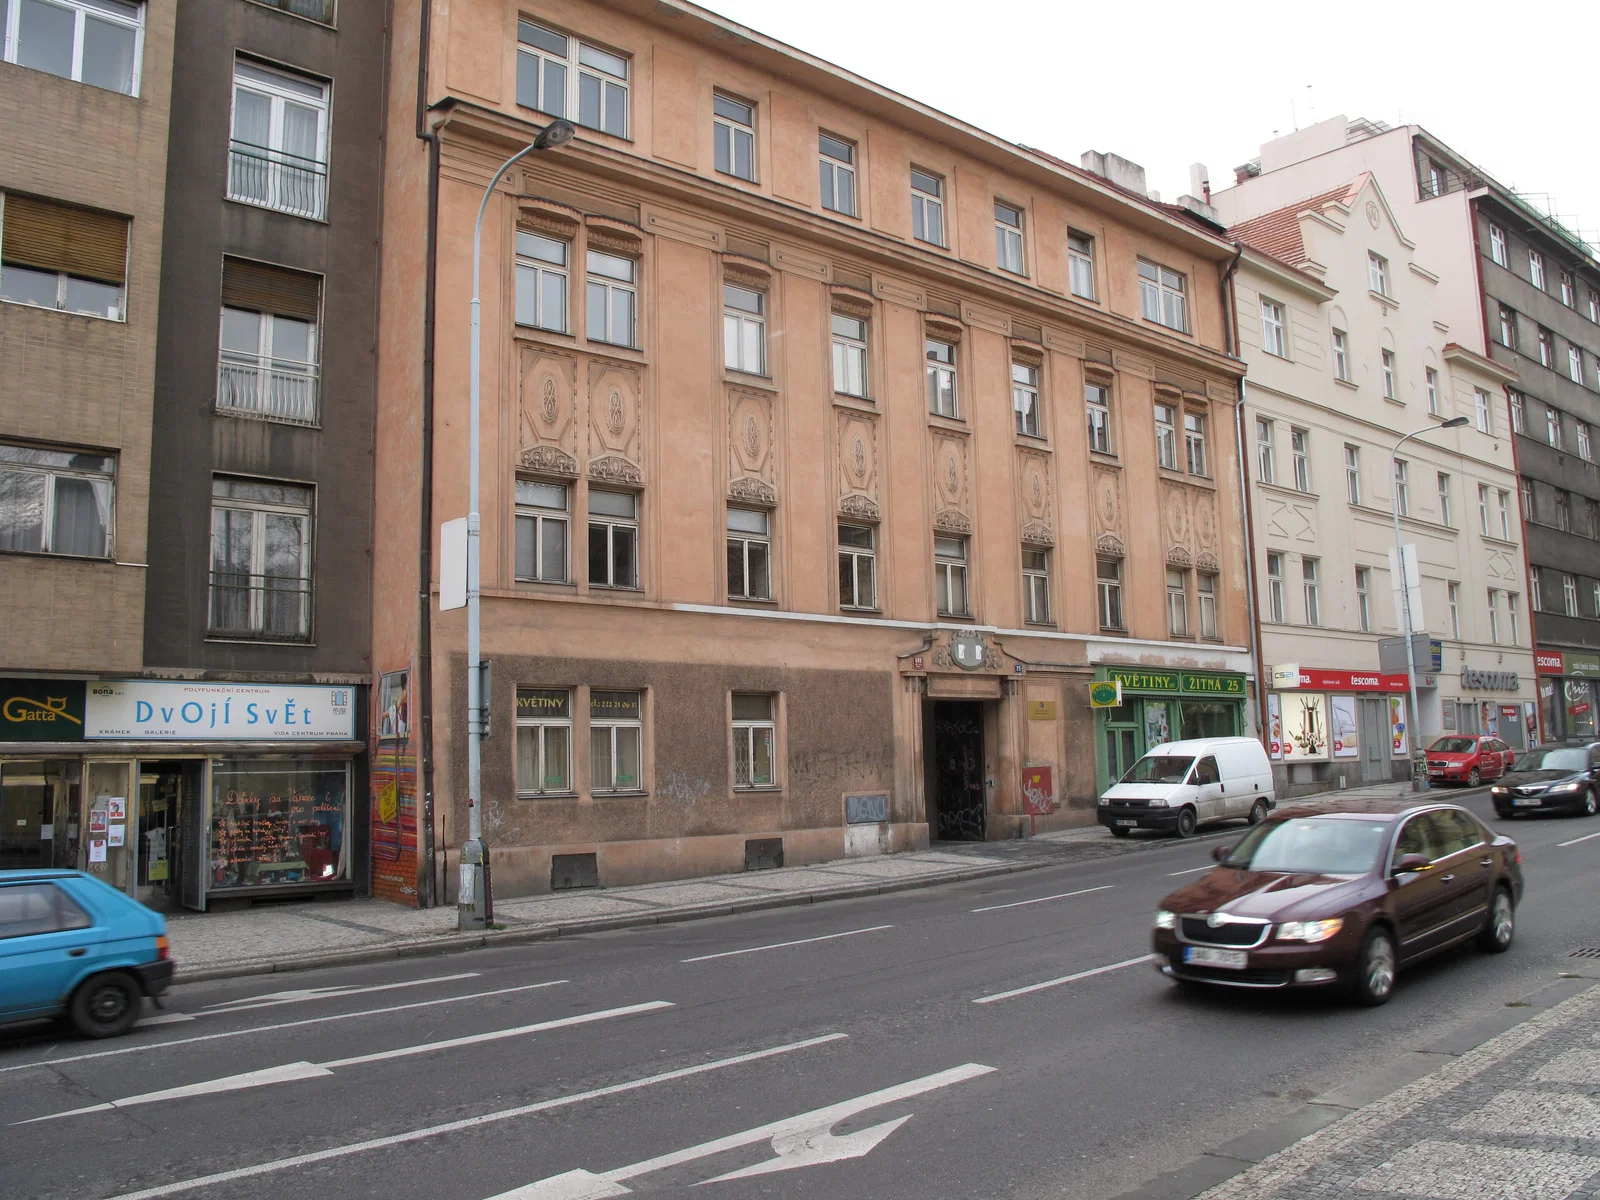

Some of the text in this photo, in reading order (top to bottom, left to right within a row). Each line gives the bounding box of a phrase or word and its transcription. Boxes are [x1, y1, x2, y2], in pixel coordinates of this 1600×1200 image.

[1537, 656, 1561, 668] escoma.
[1115, 673, 1170, 688] KVĚTINY
[1189, 677, 1239, 691] ŽITNÁ 25
[516, 695, 564, 708] KVĚTINY
[3, 697, 67, 723] Gatta
